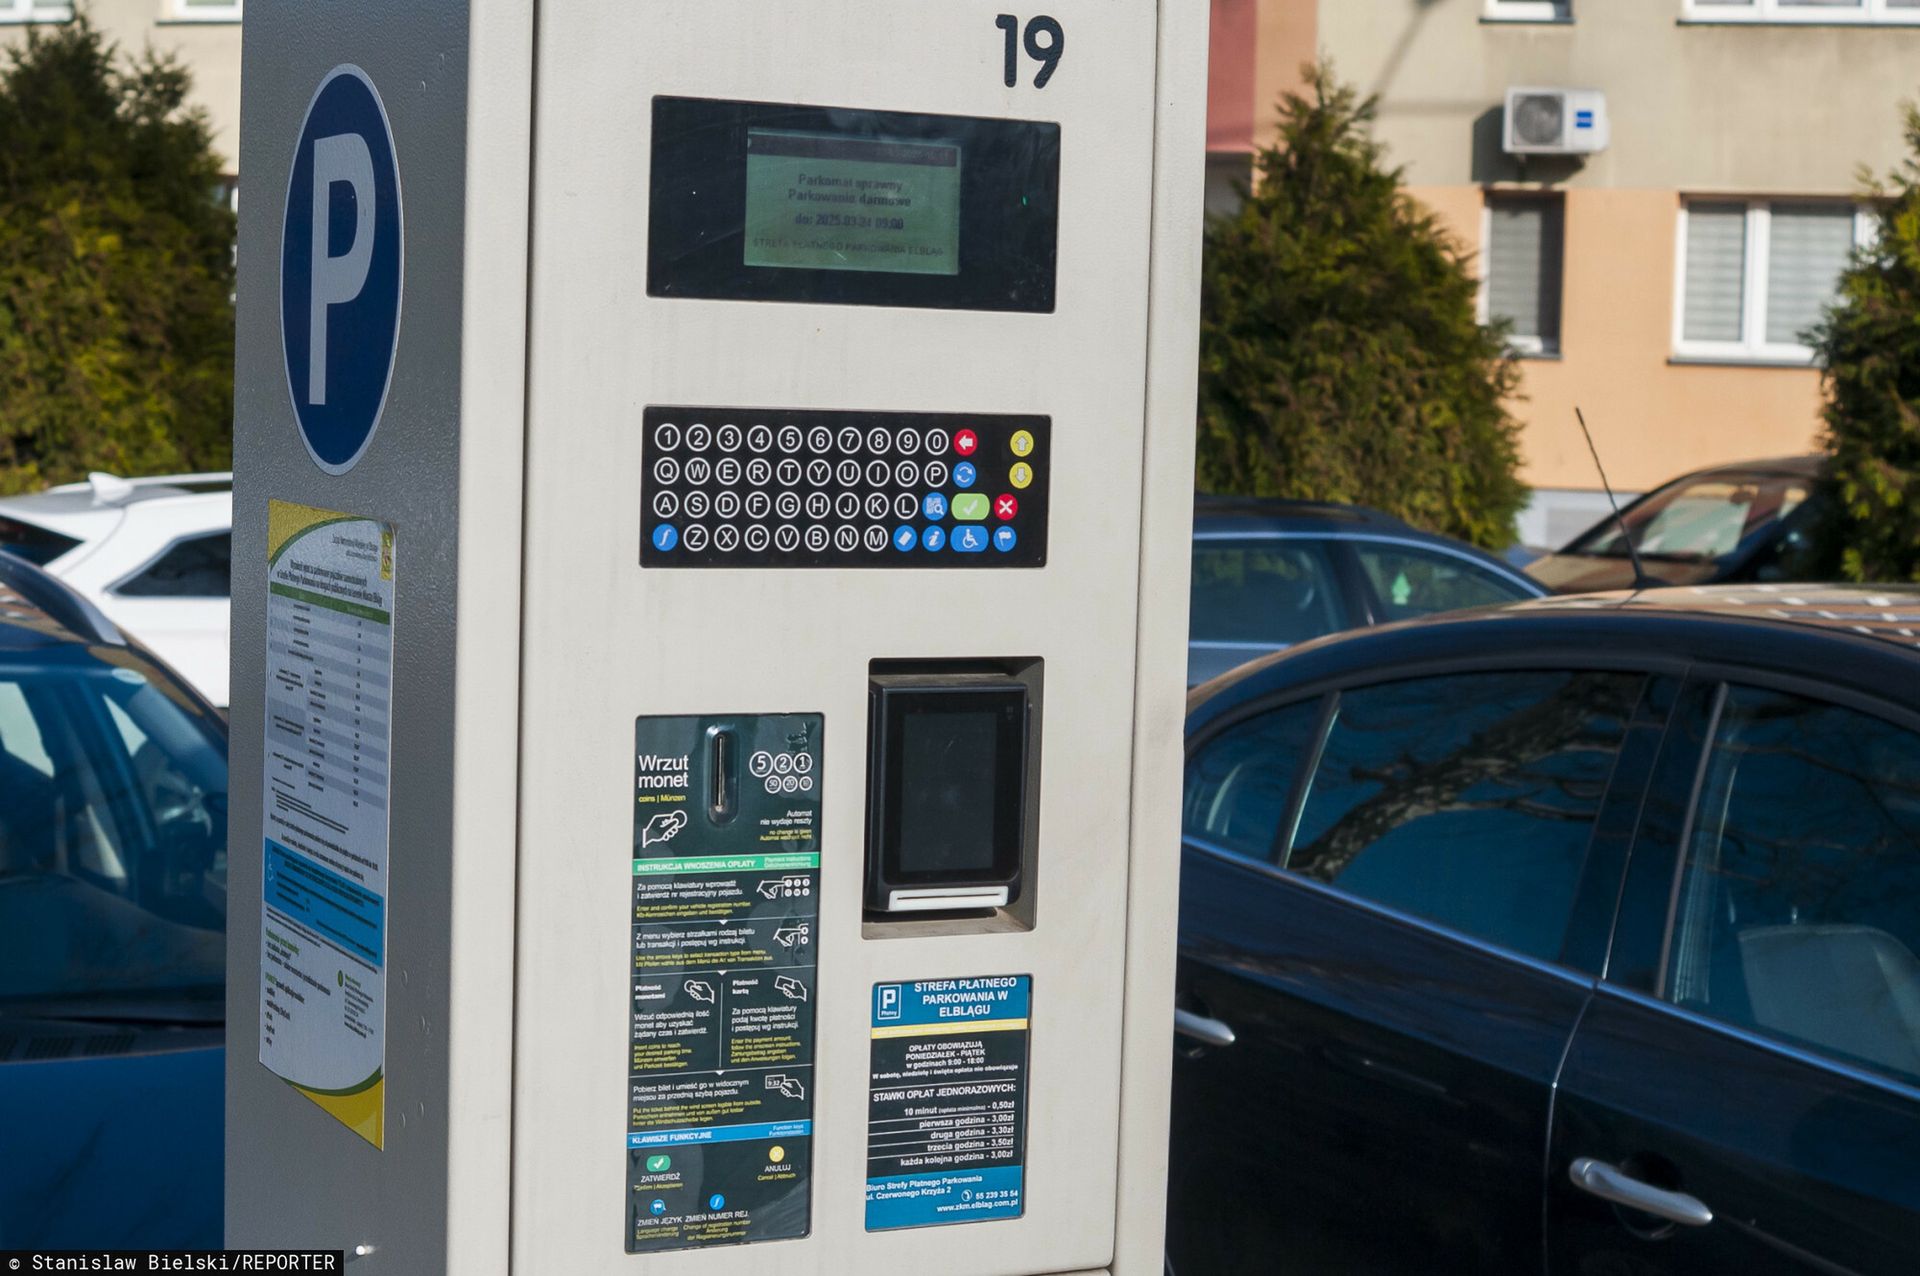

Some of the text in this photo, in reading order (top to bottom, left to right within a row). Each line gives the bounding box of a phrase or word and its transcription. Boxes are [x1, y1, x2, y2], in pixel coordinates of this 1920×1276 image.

[994, 13, 1065, 89] 19
[309, 132, 376, 405] P
[694, 430, 704, 446] 2
[724, 430, 734, 446] 3
[755, 431, 765, 446] 4
[786, 432, 795, 447] 5
[816, 432, 825, 447] 6
[845, 433, 855, 448] 7
[874, 433, 884, 448] 8
[904, 434, 913, 449] 9
[932, 434, 942, 449] 0
[660, 462, 674, 479] Q
[690, 464, 705, 479] W
[723, 464, 734, 479] E
[752, 464, 764, 480] R
[784, 464, 795, 480] T
[814, 465, 825, 480] Y
[843, 466, 855, 480] U
[901, 466, 914, 482] O
[930, 466, 941, 481] P
[660, 496, 910, 514] A S D F G H J K L
[690, 530, 702, 545] Z
[721, 530, 732, 545] X
[751, 530, 763, 546] C
[781, 531, 794, 545] V
[812, 530, 822, 546] B
[841, 531, 853, 546] N
[869, 531, 883, 546] M
[638, 754, 689, 771] Wrzut
[756, 755, 767, 770] 5
[638, 771, 689, 788] monet
[786, 810, 813, 818] Automat
[760, 818, 770, 826] nie
[637, 862, 683, 872] INSTRUKCJA
[684, 861, 727, 870] WNOSZENIA
[727, 859, 756, 869] OPŁATY
[637, 883, 647, 891] Za
[914, 977, 1017, 993] STREFA PŁATNEGO
[634, 992, 666, 1001] monetami
[882, 988, 897, 1010] P
[922, 990, 1009, 1005] PARKOWANIA W
[732, 1007, 741, 1016] Za
[939, 1004, 991, 1018] ELBLĄGU
[908, 1040, 983, 1053] OPŁATY OBOWIĄZUJĄ
[905, 1047, 986, 1061] PONIEDZIAŁEK PIĄTEK
[913, 1060, 947, 1070] godzinach
[633, 1085, 657, 1094] Pobierz
[657, 1083, 671, 1092] bilet
[873, 1083, 1016, 1102] STAWKI OPŁAT JEDNORAZOWYCH:
[904, 1107, 914, 1116] 10
[914, 1106, 937, 1115] minut
[919, 1117, 954, 1129] pierwsza
[954, 1115, 985, 1127] godzina
[632, 1130, 712, 1144] KLAWISZE FUNKCYJNE
[930, 1130, 953, 1141] druga
[954, 1127, 985, 1139] godzina
[927, 1141, 953, 1151] trzecia
[954, 1139, 985, 1150] godzina
[900, 1157, 923, 1167] każda
[953, 1151, 984, 1163] godzina
[764, 1163, 792, 1174] ANULUJ
[640, 1171, 681, 1183] ZATWIERDŹ
[866, 1183, 886, 1193] Biuro
[886, 1181, 908, 1192] Strefy
[941, 1174, 983, 1185] Parkowania
[875, 1189, 920, 1200] Czerwonego
[660, 1215, 683, 1227] JĘZYK
[708, 1210, 733, 1221] NUMER
